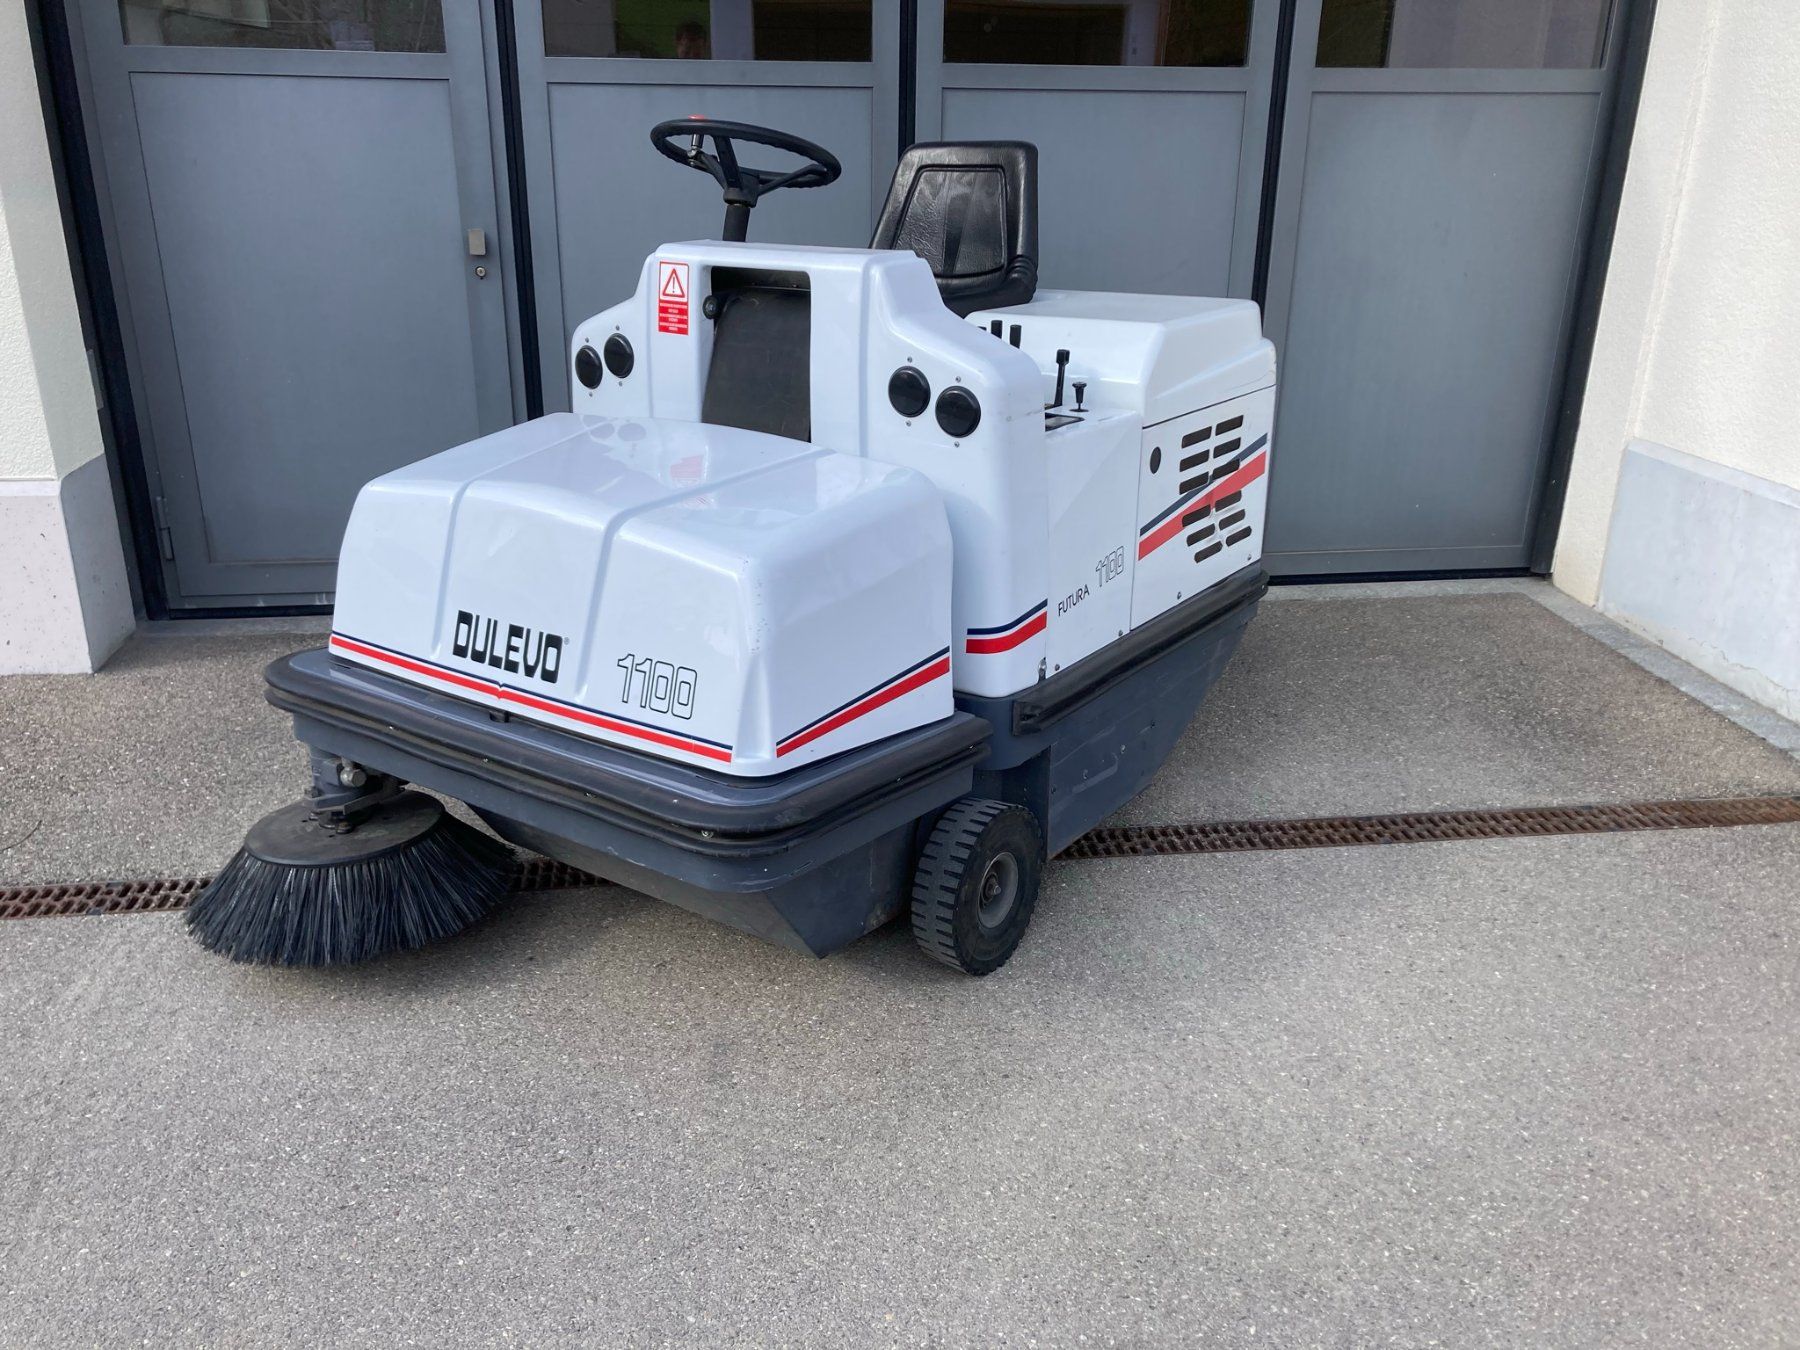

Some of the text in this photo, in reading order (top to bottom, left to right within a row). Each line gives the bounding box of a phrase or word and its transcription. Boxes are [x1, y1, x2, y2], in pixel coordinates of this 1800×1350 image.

[1058, 545, 1125, 616] FUTURA 1100
[452, 610, 564, 684] DULEVO
[617, 653, 698, 720] 1100
